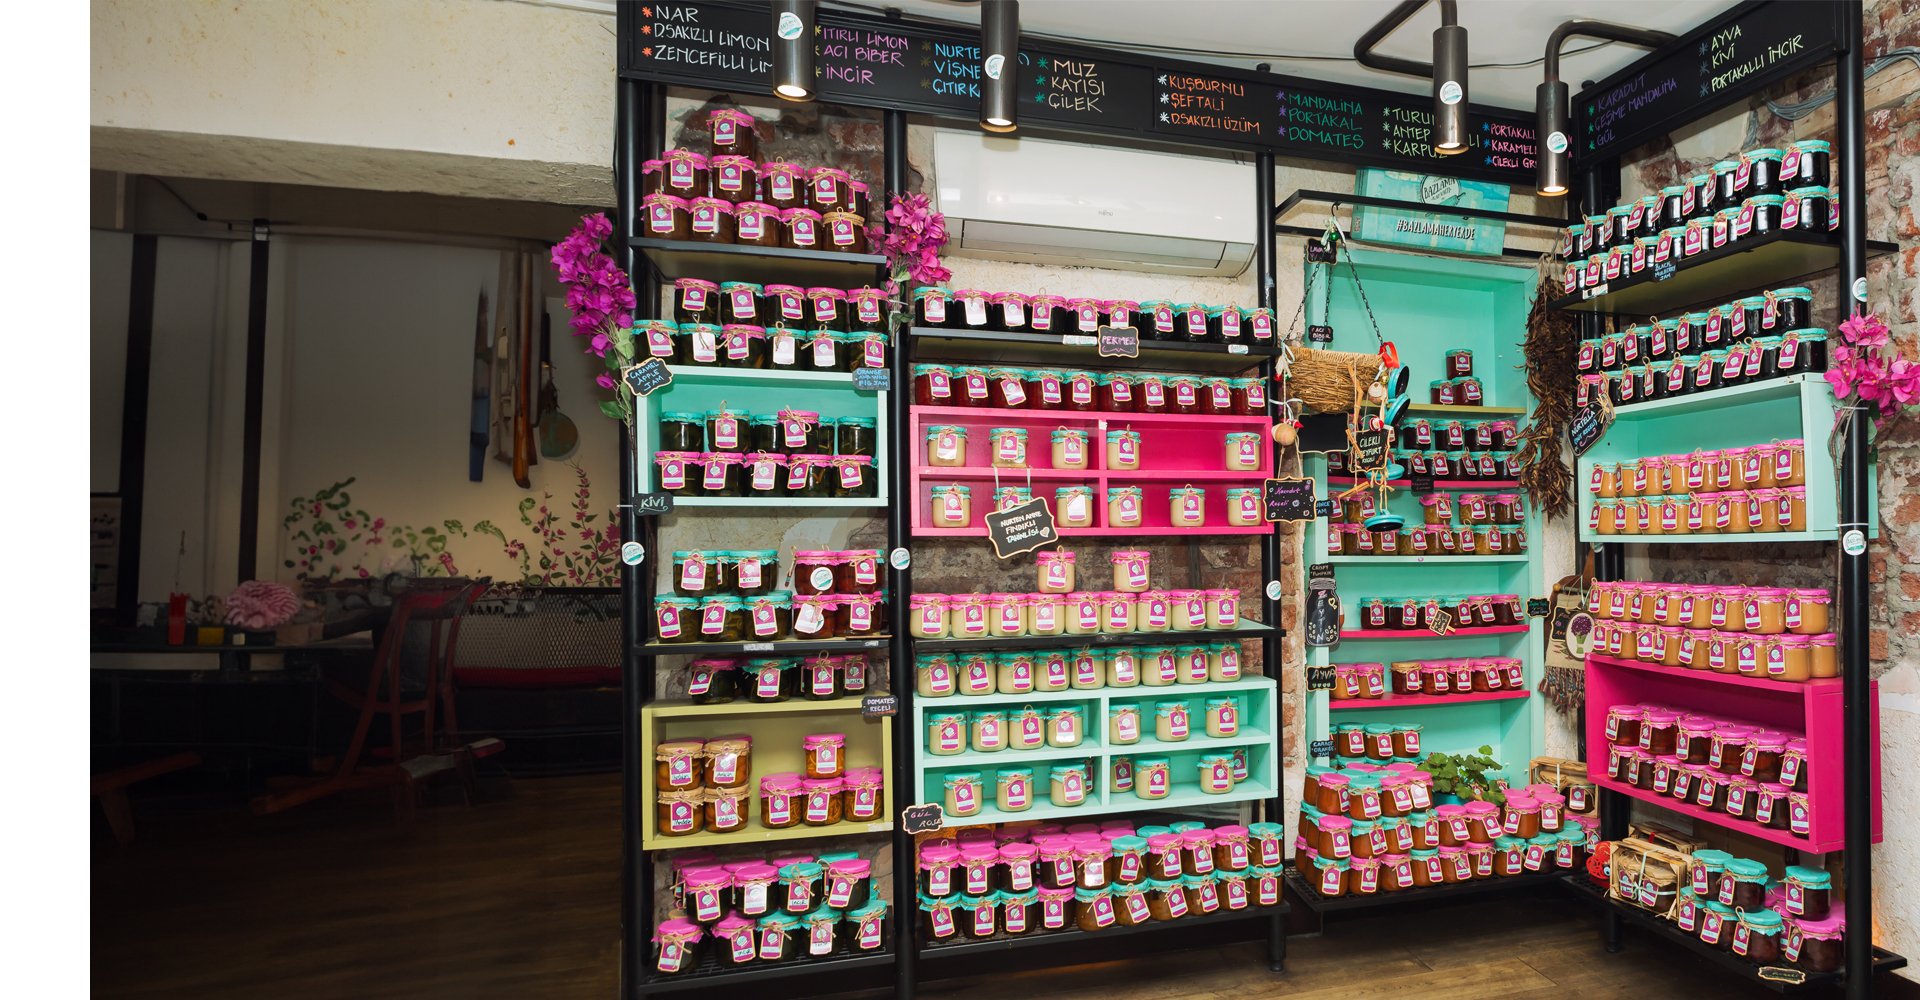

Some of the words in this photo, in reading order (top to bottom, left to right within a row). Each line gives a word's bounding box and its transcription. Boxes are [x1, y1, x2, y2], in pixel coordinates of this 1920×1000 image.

[655, 5, 699, 23] NAR
[719, 30, 770, 52] LİMON
[823, 27, 860, 43] ITIRLI
[867, 30, 909, 51] LİMON
[1711, 24, 1742, 52] AYVA
[654, 44, 745, 70] ZENCEFİLLİ
[824, 44, 848, 59] ACI
[855, 46, 905, 67] BİBER
[934, 43, 981, 60] NURTE
[1712, 42, 1735, 69] KİVİ
[933, 60, 981, 80] VİŞNE
[1053, 59, 1098, 78] MUZ
[1711, 54, 1765, 92] PORTAKALLI
[1767, 34, 1804, 64] İNCİR
[826, 63, 875, 85] İNCİR
[1051, 76, 1106, 97] KAYISI
[1169, 75, 1245, 97] KUŞBURNU
[1597, 72, 1647, 112] KARADUT
[1628, 77, 1678, 112] MANDALİNA
[1048, 92, 1103, 113] ÇİLEK
[1170, 92, 1225, 112] ŞEFTALİ
[1288, 93, 1364, 116] MANDALİNA
[1223, 116, 1261, 135] ÜZÜM
[1288, 107, 1363, 131] PORTAKAL
[1392, 107, 1435, 126] TURU
[1288, 126, 1365, 149] DOMATES
[1393, 126, 1431, 141] ANTEP
[1596, 128, 1616, 146] GÜL
[1101, 335, 1136, 346] PEKMEZ
[629, 361, 660, 379] CARAMEL
[637, 369, 660, 386] APPLE
[643, 375, 665, 391] JAM
[1311, 668, 1336, 680] AYVA
